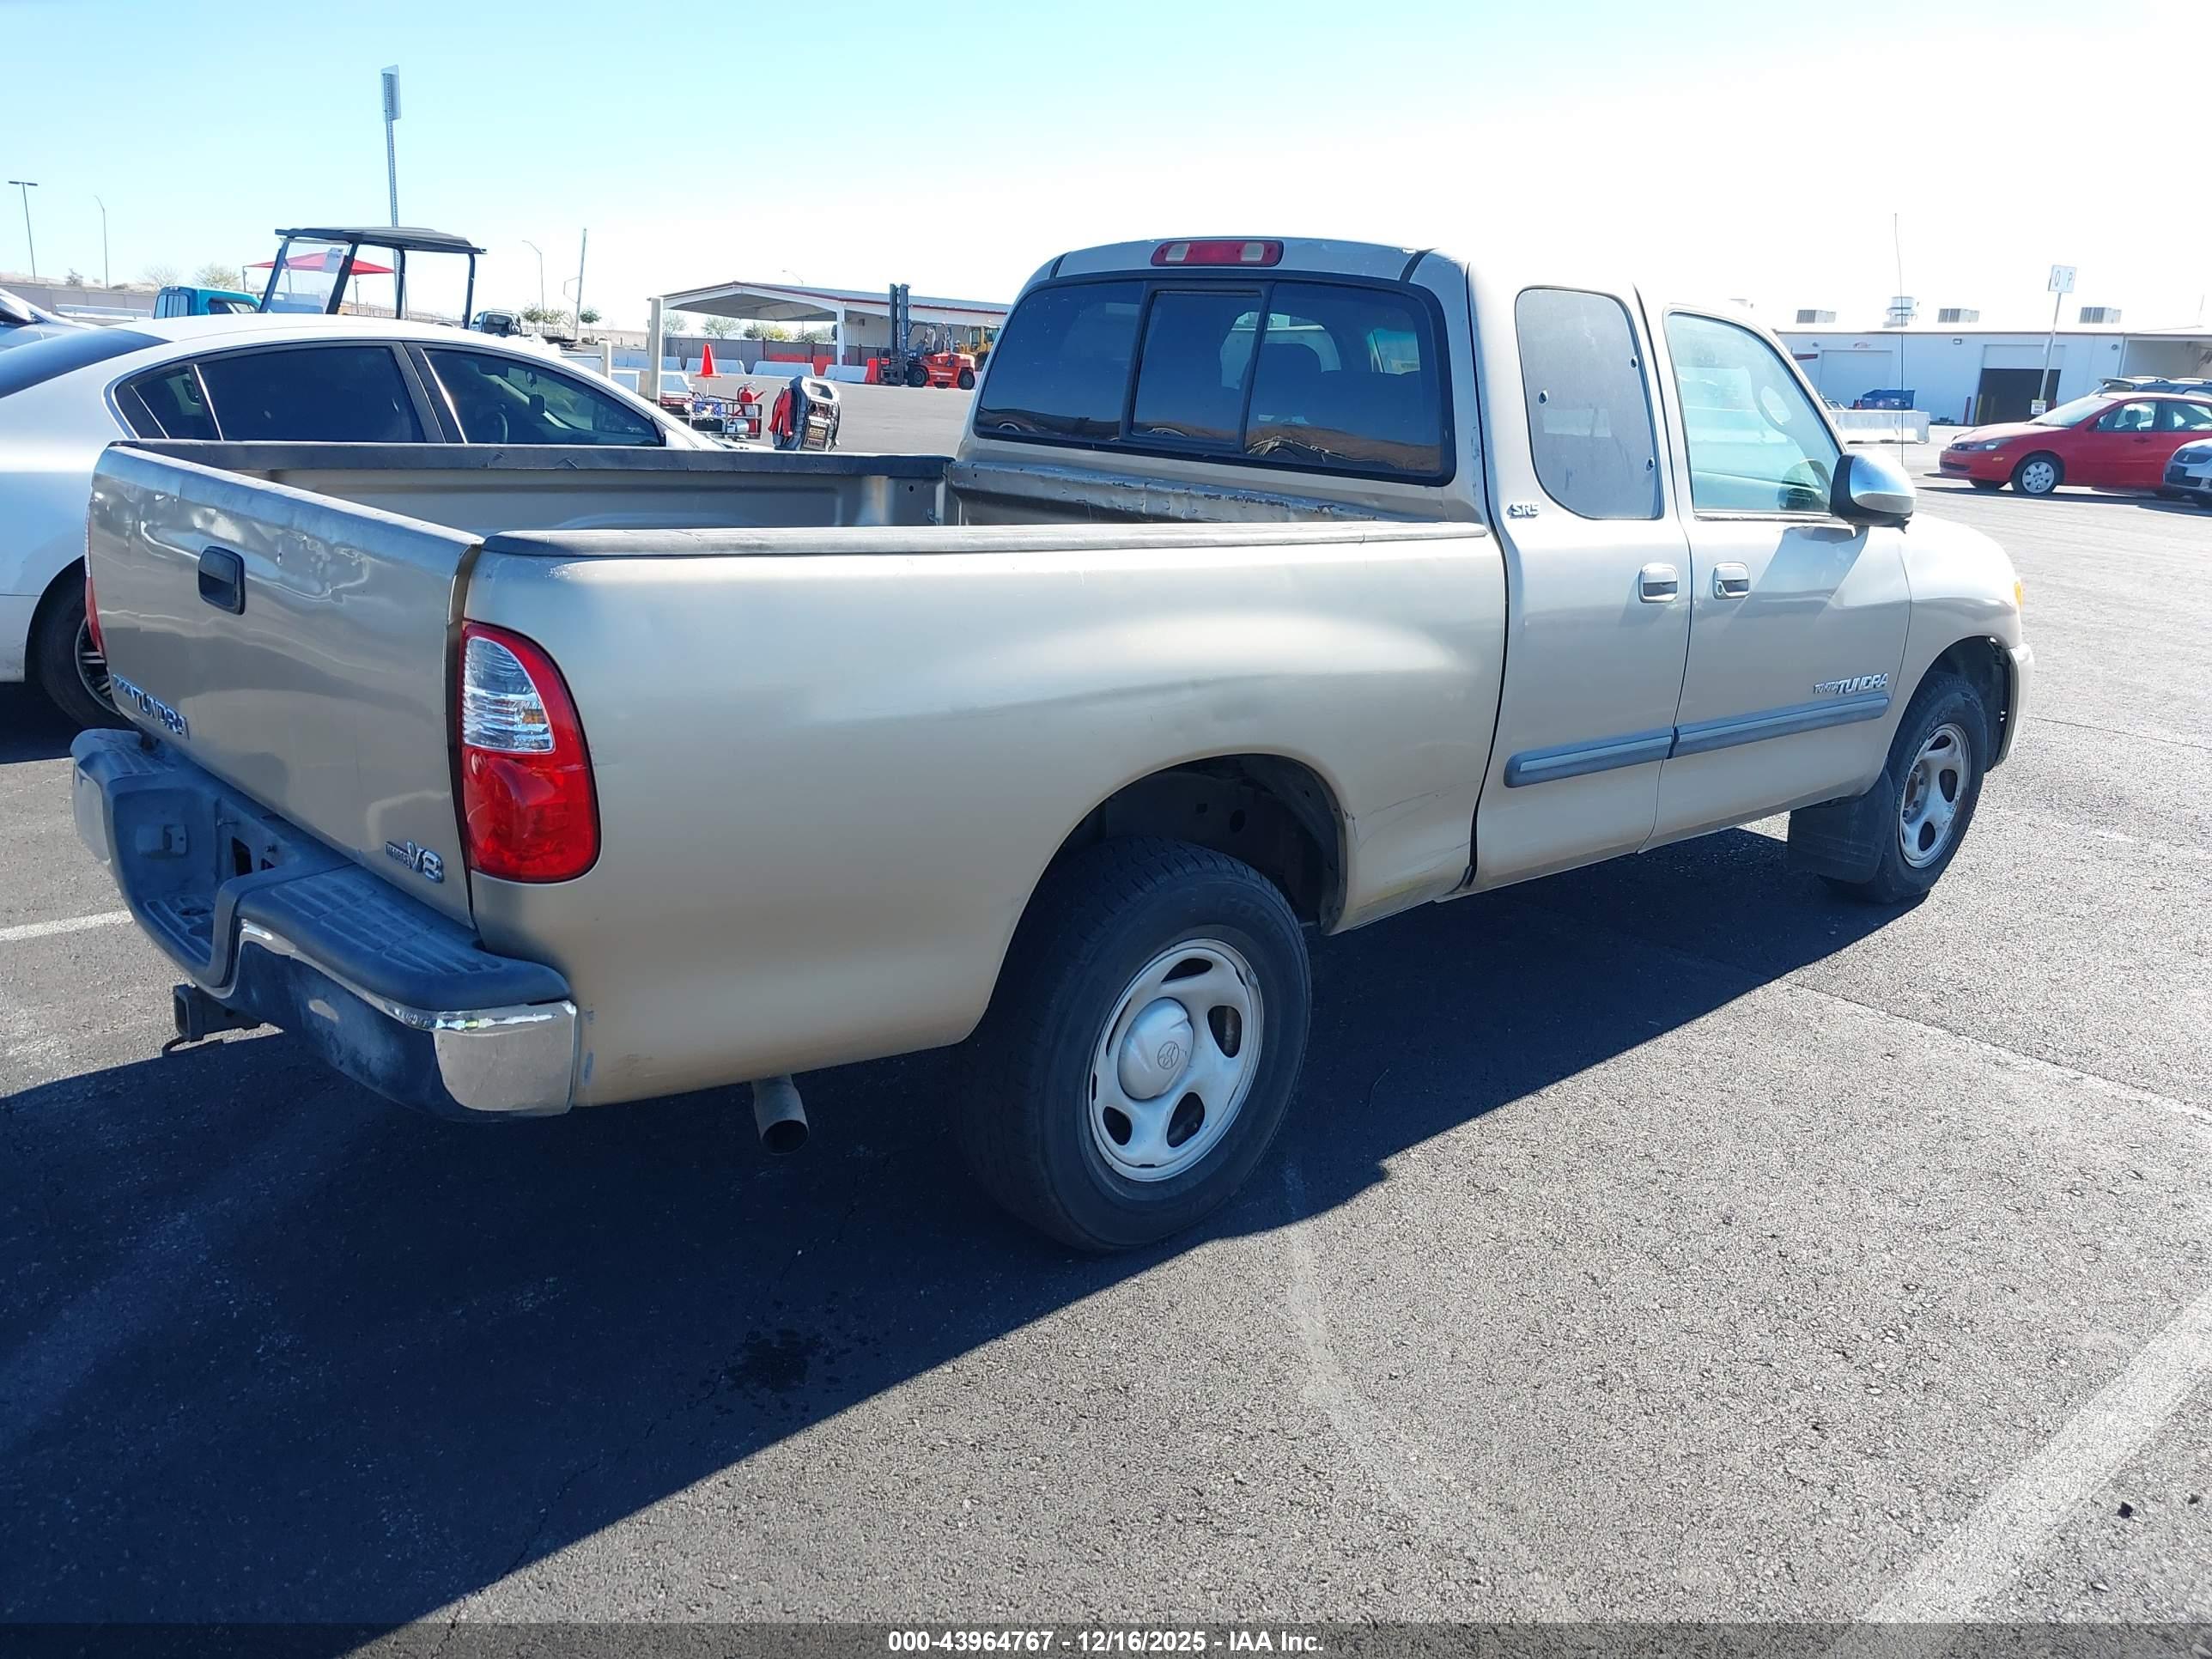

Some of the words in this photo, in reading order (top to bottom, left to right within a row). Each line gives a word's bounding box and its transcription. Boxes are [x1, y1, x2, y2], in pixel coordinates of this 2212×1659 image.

[2067, 272, 2073, 288] P
[1509, 503, 1539, 518] SR5
[1837, 672, 1888, 694] TUNDRA
[130, 685, 185, 735] TUNDRA
[407, 840, 444, 883] V8
